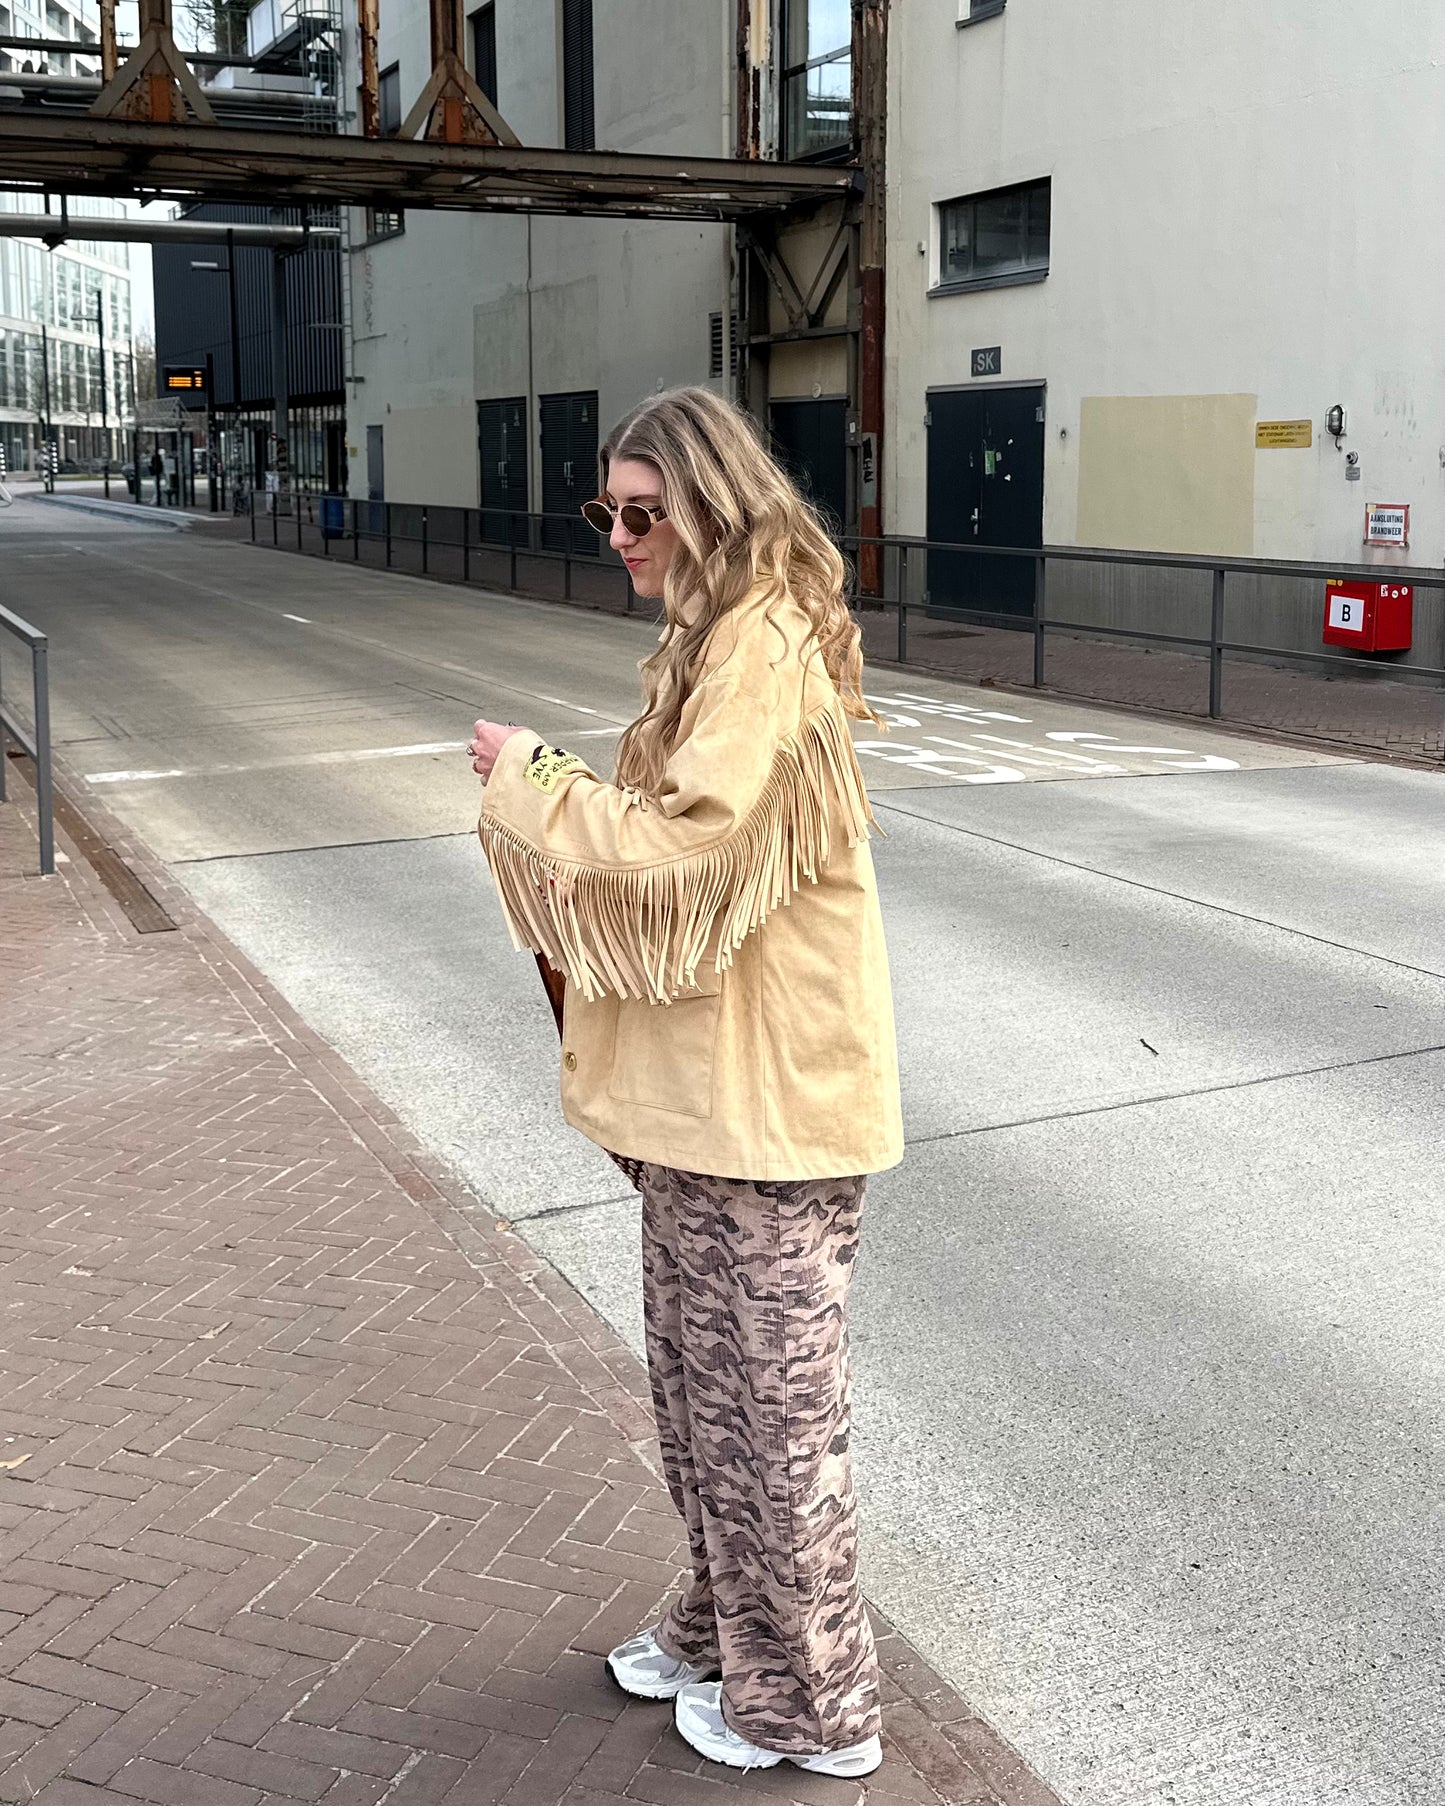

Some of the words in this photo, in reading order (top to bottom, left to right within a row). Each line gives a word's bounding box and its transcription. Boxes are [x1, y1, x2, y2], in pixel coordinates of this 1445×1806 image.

[977, 352, 994, 371] SK
[1370, 514, 1403, 523] AANSLUITING
[1370, 526, 1401, 535] BRANDWEER
[1342, 604, 1351, 622] B
